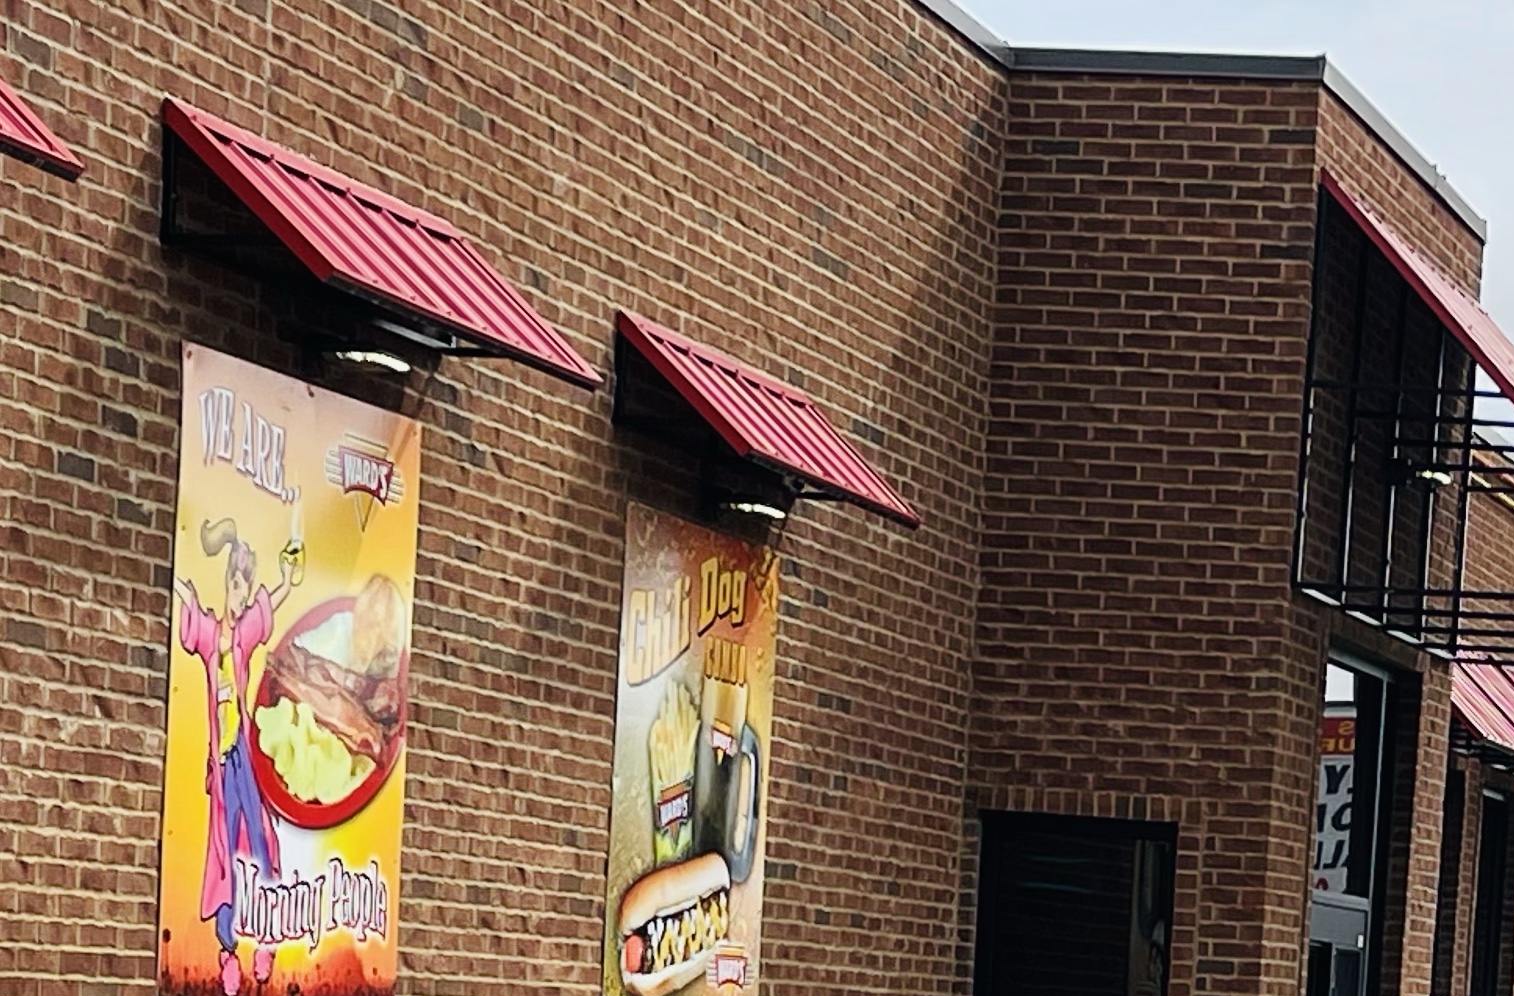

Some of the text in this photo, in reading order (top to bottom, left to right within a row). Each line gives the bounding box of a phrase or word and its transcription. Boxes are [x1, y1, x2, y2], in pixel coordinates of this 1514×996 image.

[199, 386, 235, 466] WE
[627, 556, 747, 687] Chili Dog
[235, 857, 387, 953] Morning People
